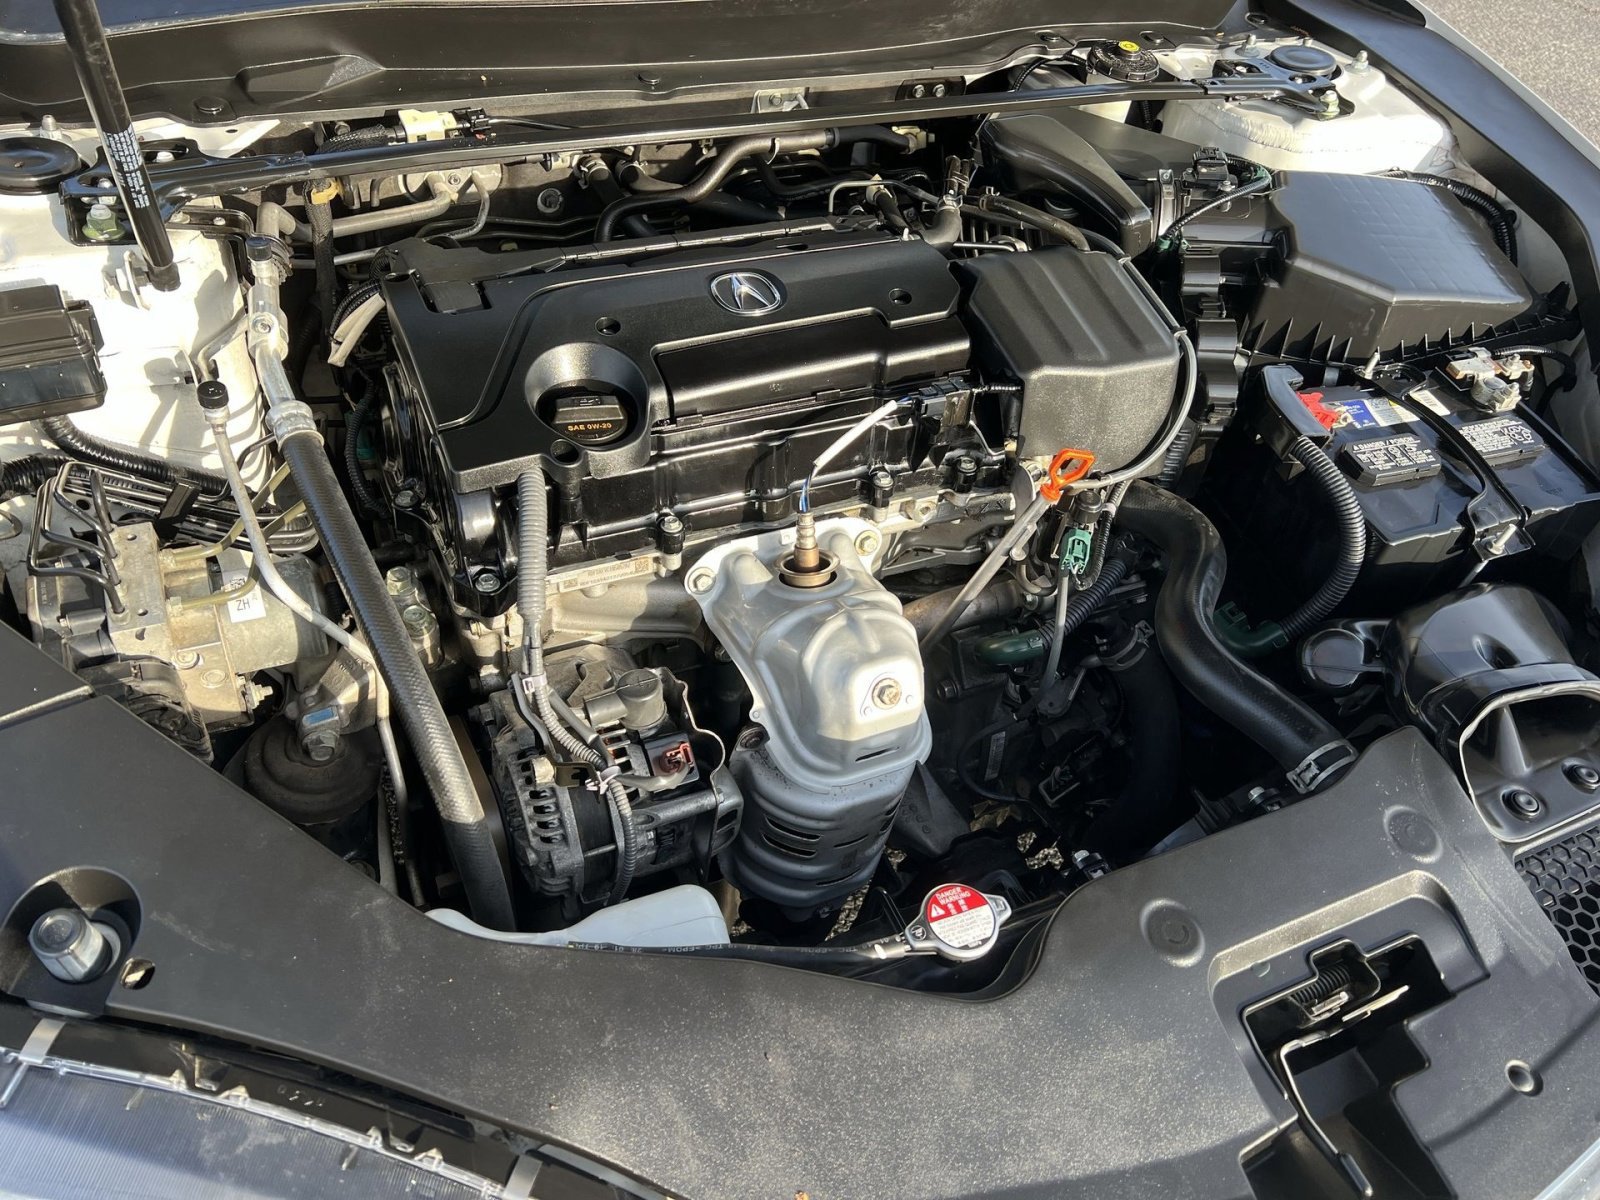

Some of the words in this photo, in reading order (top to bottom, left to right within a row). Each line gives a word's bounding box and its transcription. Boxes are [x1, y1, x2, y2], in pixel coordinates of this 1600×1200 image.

[587, 422, 612, 430] 0W-20
[235, 598, 251, 611] ZH
[935, 886, 961, 899] DANGER
[939, 891, 971, 905] WARNING
